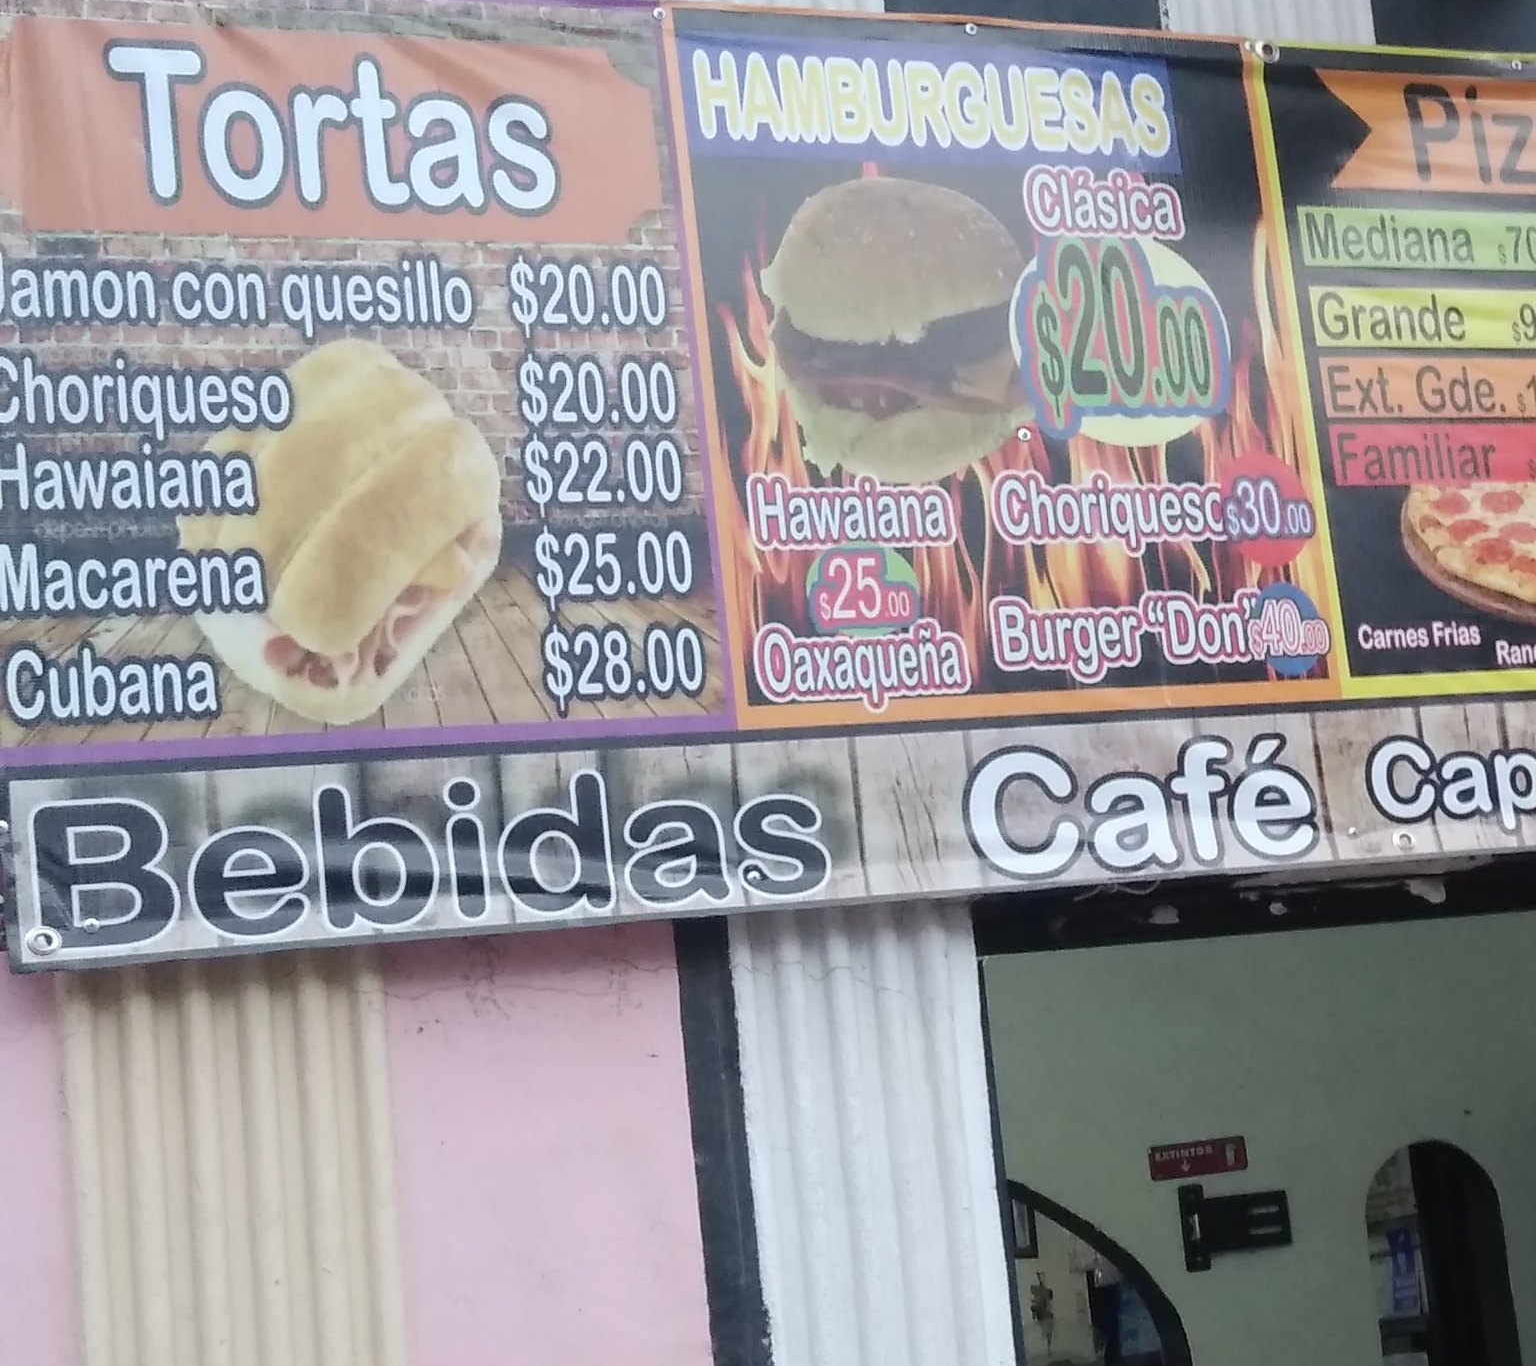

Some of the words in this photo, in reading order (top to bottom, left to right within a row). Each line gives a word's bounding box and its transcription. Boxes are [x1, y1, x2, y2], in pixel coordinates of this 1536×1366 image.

[106, 42, 559, 212] Tortas
[692, 49, 1172, 157] HAMBURGUESAS
[1030, 171, 1178, 235] Clásica
[1305, 214, 1476, 265] Mediana
[172, 270, 267, 321] con
[282, 259, 474, 338] quesillo
[510, 254, 668, 333] $20.00
[1035, 237, 1215, 429] $20.00
[1316, 292, 1466, 344] Grande
[0, 354, 291, 441] Choriqueso
[519, 353, 678, 442] $20.00
[1327, 364, 1403, 415] Ext.
[1415, 366, 1507, 414] Gde.
[0, 441, 256, 511] Hawaiana
[525, 433, 683, 523] $22.00
[1337, 429, 1496, 482] Familiar
[754, 479, 949, 544] Hawaiana
[1226, 479, 1312, 536] $30.00
[0, 541, 265, 613] Macarena
[535, 524, 693, 610] $25.00
[819, 556, 912, 620] $25.00
[6, 644, 218, 721] Cubana
[545, 622, 704, 711] $28.00
[763, 624, 964, 705] Oaxaqueña
[999, 604, 1139, 677] Burger
[1251, 598, 1328, 658] $40.00
[1358, 626, 1429, 650] Carnes
[1432, 624, 1482, 647] Frias
[29, 769, 831, 950] Bebidas
[967, 735, 1317, 879] Café
